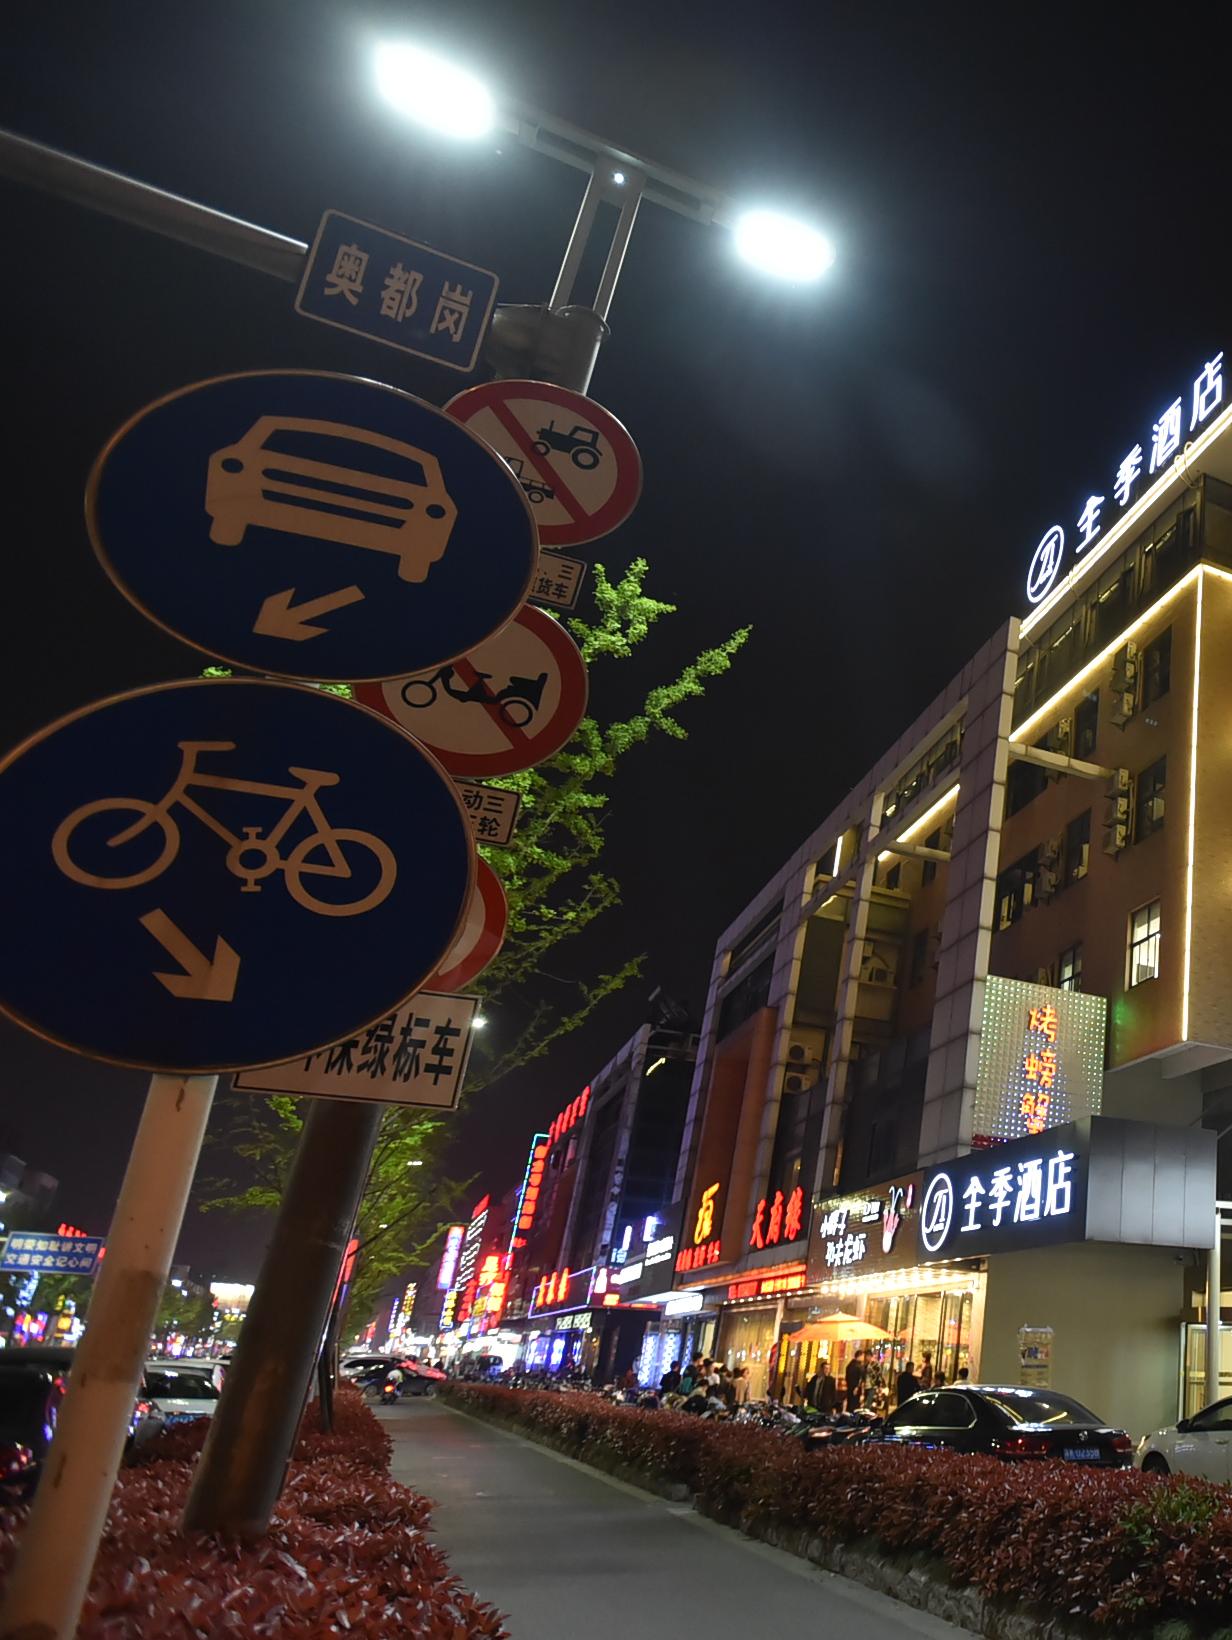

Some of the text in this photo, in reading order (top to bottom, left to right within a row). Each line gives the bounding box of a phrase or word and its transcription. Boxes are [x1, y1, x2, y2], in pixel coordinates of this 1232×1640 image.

[323, 243, 474, 343] 奥都岗
[1075, 351, 1224, 554] 全季酒店
[531, 577, 570, 600] 货车
[304, 1012, 462, 1086] 绿标车
[1020, 1003, 1059, 1135] 烤螃蟹
[959, 1149, 1075, 1233] 全季酒店
